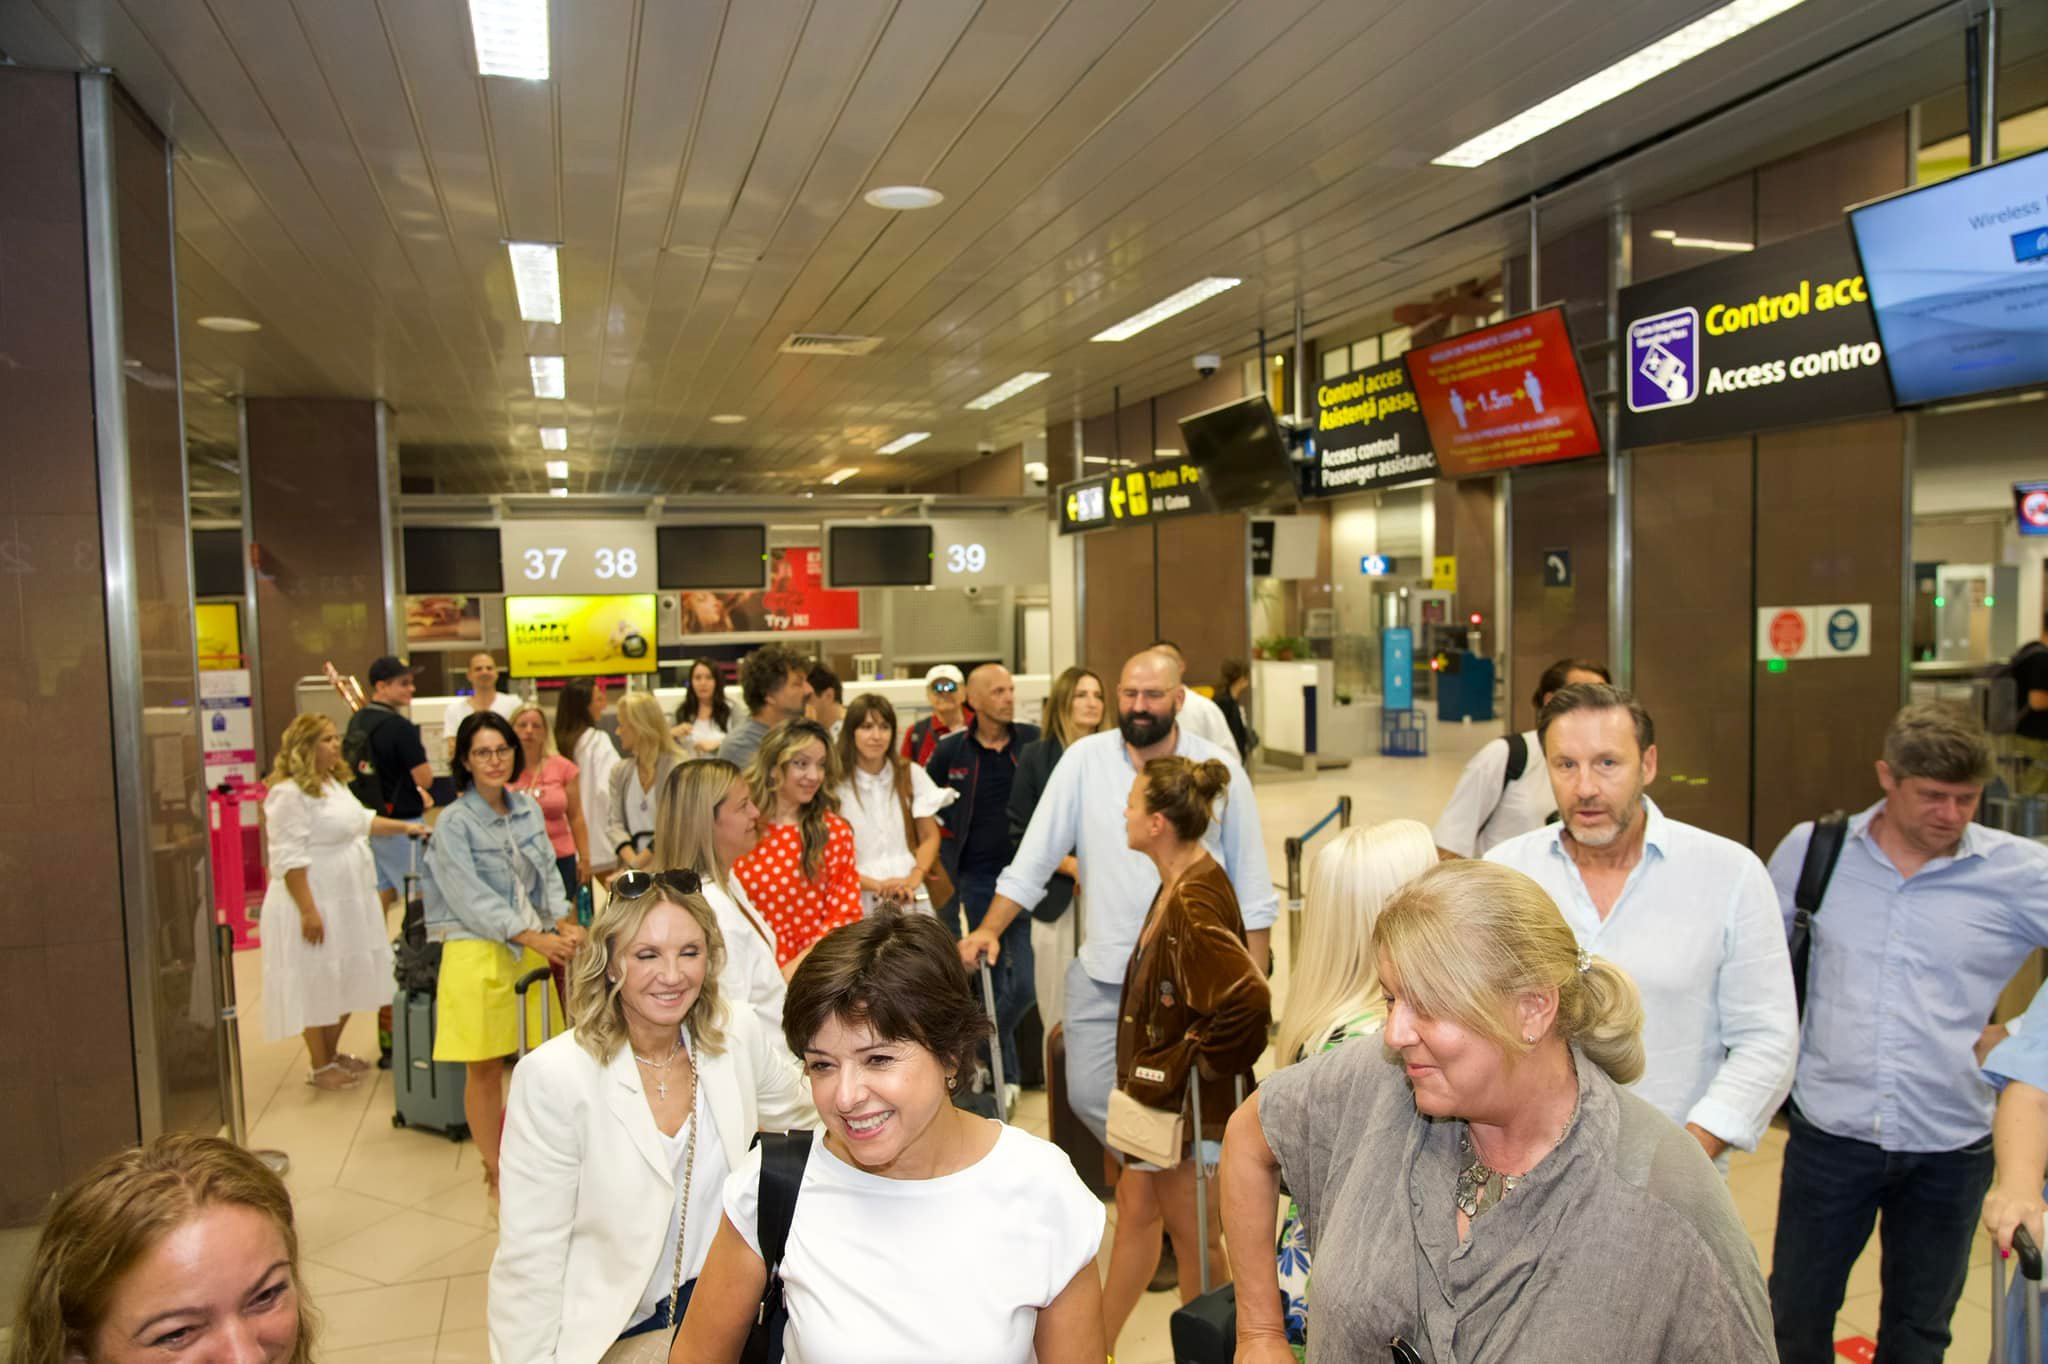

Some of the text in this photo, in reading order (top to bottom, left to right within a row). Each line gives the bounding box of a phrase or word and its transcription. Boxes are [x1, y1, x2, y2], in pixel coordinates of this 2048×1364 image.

[1968, 201, 2042, 231] Wireless
[1705, 280, 1811, 336] Control
[1815, 275, 1868, 311] acc
[1705, 341, 1882, 395] Access contro
[1318, 373, 1365, 408] Control
[1366, 367, 1403, 394] acces
[1477, 388, 1514, 412] 1.5m
[1321, 432, 1400, 468] Access control
[1322, 463, 1378, 487] Passenger
[523, 547, 638, 580] 37 38
[946, 543, 986, 574] 39
[514, 623, 568, 634] HAPPY
[764, 613, 790, 629] Try
[516, 635, 571, 645] SUMMER
